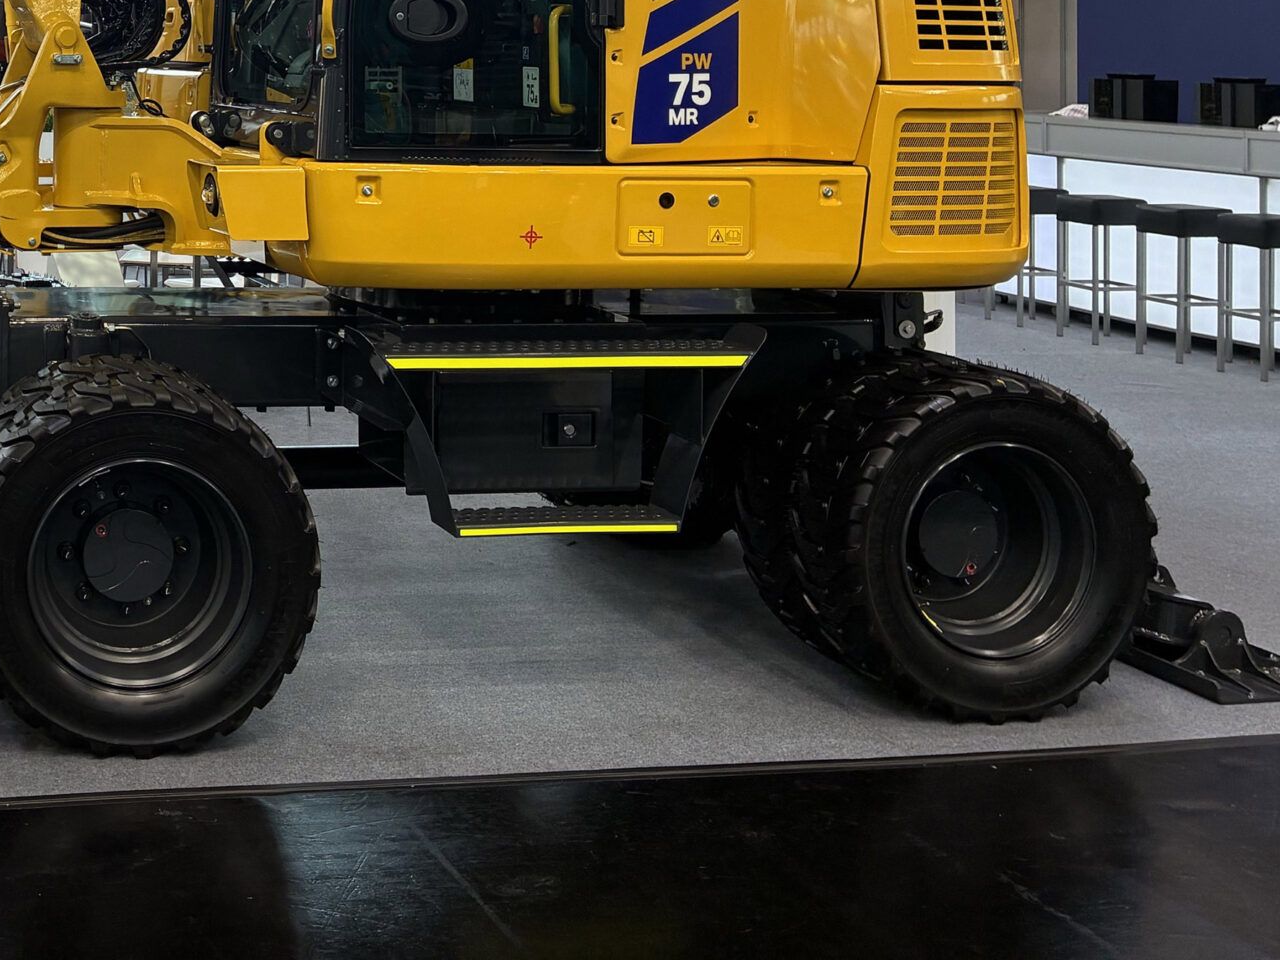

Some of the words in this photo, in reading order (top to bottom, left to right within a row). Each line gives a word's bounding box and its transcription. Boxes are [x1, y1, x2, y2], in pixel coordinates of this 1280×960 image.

[681, 53, 712, 70] PW
[668, 73, 712, 106] 75
[668, 108, 699, 126] MR
